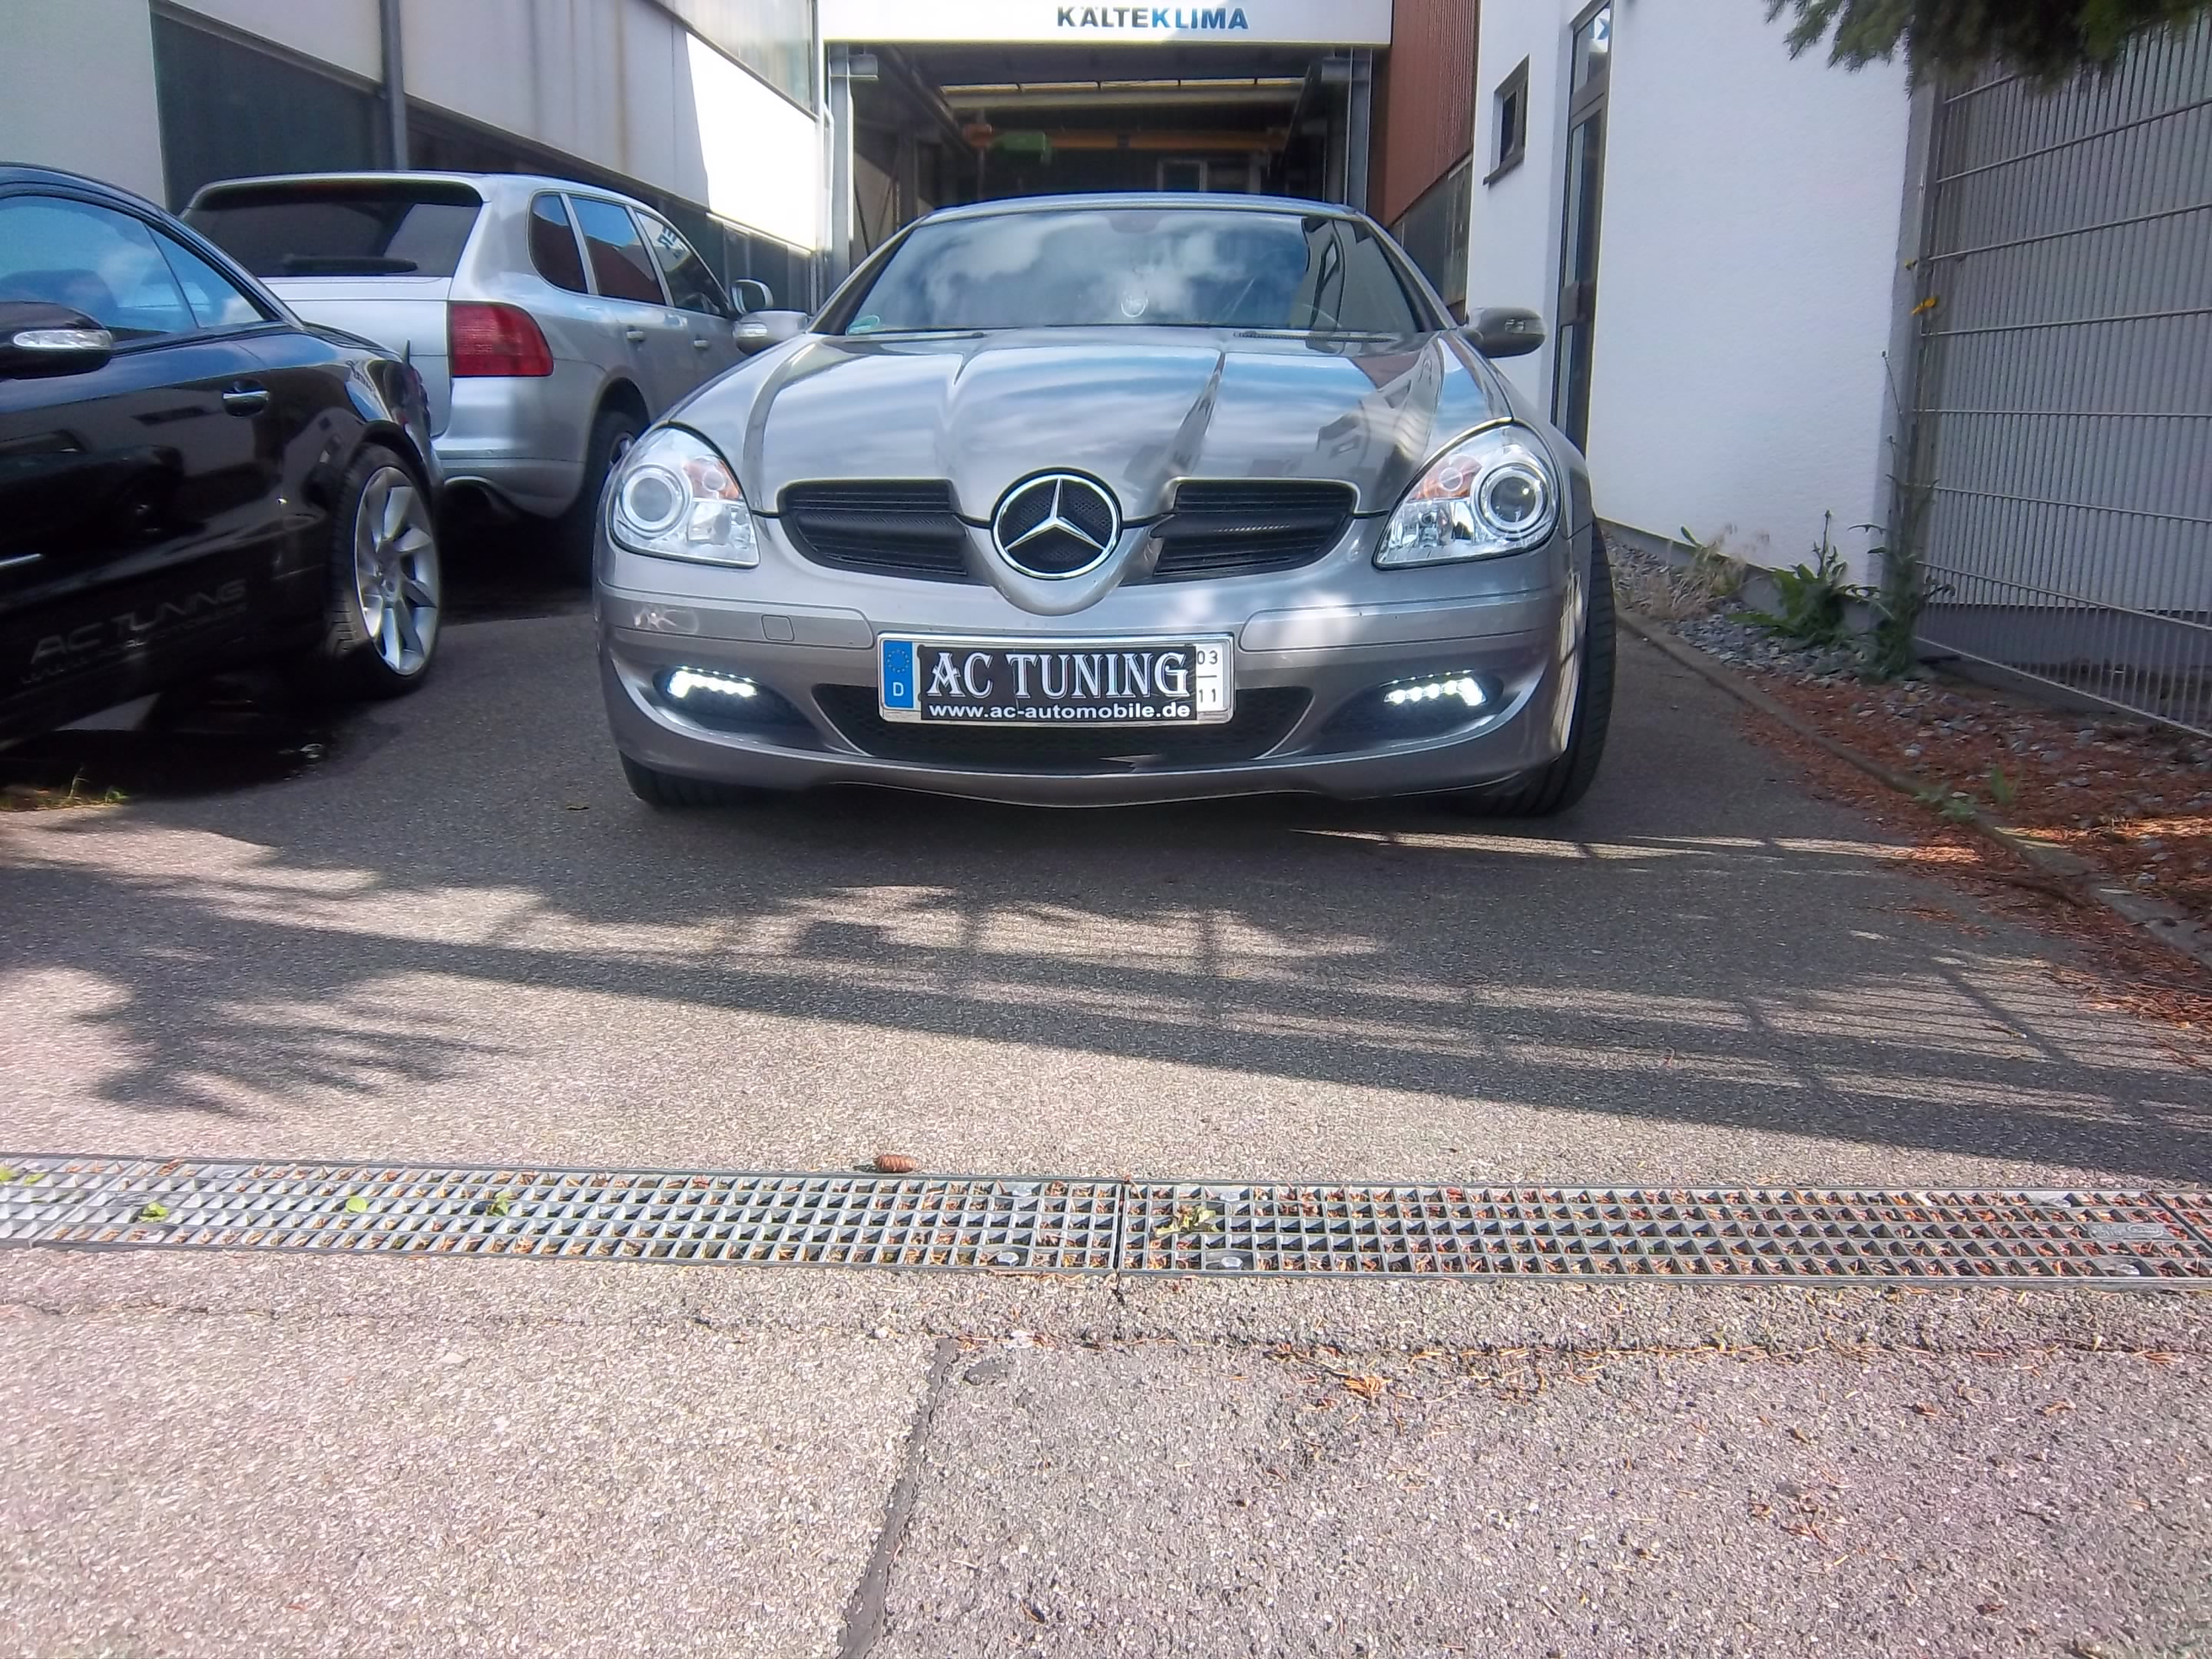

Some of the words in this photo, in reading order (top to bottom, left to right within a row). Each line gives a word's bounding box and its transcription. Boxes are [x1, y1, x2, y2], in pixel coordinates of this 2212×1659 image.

[1197, 650, 1219, 665] 03
[926, 651, 993, 698] AC
[1006, 651, 1190, 699] TUNING
[892, 681, 905, 697] D
[1198, 688, 1218, 704] 11
[929, 701, 1191, 720] www.ac-automobile.de
